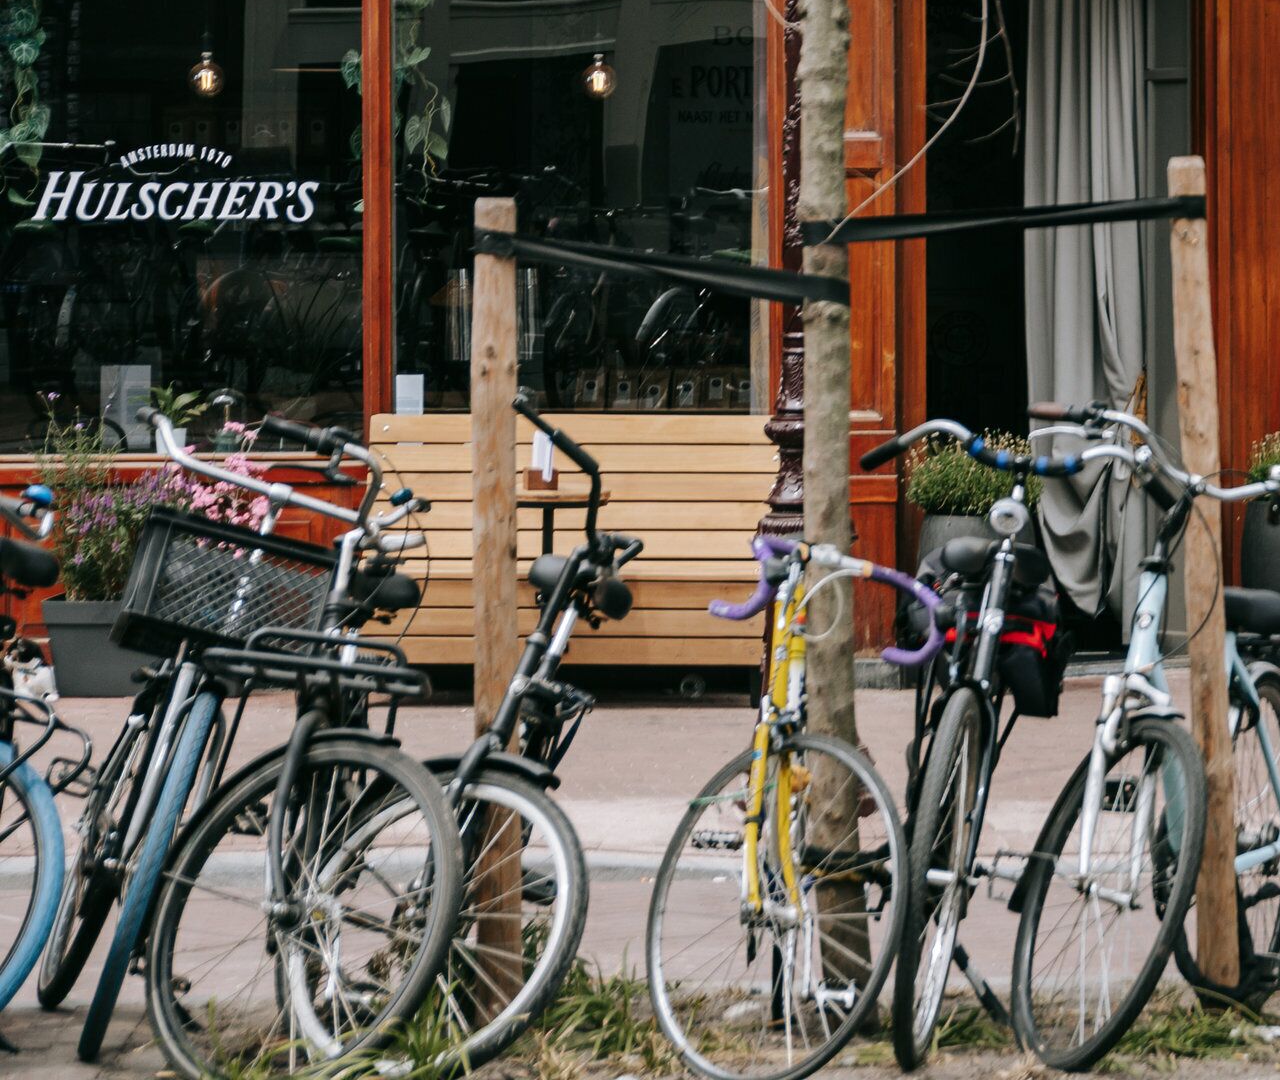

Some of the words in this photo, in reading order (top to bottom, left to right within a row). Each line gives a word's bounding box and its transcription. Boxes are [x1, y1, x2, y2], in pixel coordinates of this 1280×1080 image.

[119, 143, 195, 168] AMSTERDAM
[199, 145, 233, 168] 1870
[31, 170, 320, 223] HULSCHER'S
